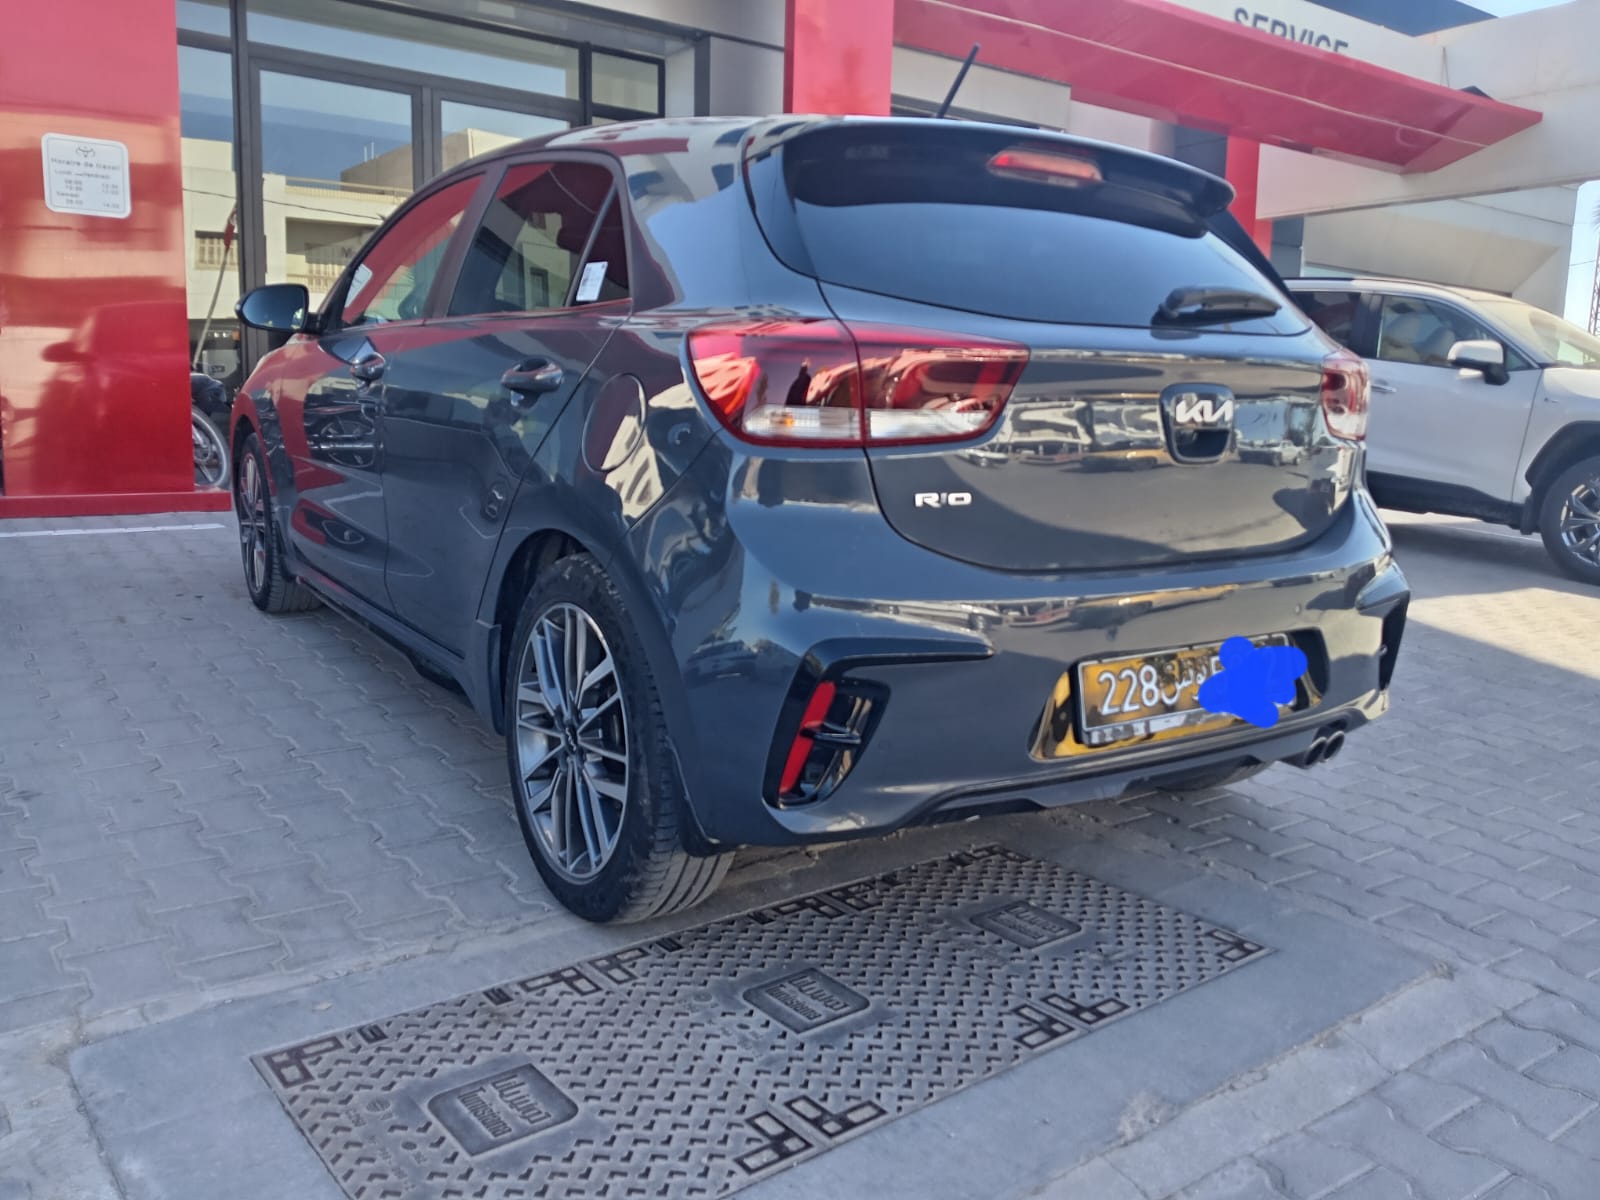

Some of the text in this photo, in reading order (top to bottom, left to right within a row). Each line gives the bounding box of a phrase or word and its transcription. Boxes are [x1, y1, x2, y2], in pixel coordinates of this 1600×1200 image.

[1176, 399, 1233, 423] KIA
[914, 492, 972, 508] RIO
[1098, 664, 1159, 715] 228
[457, 1086, 512, 1138] Tunisiana
